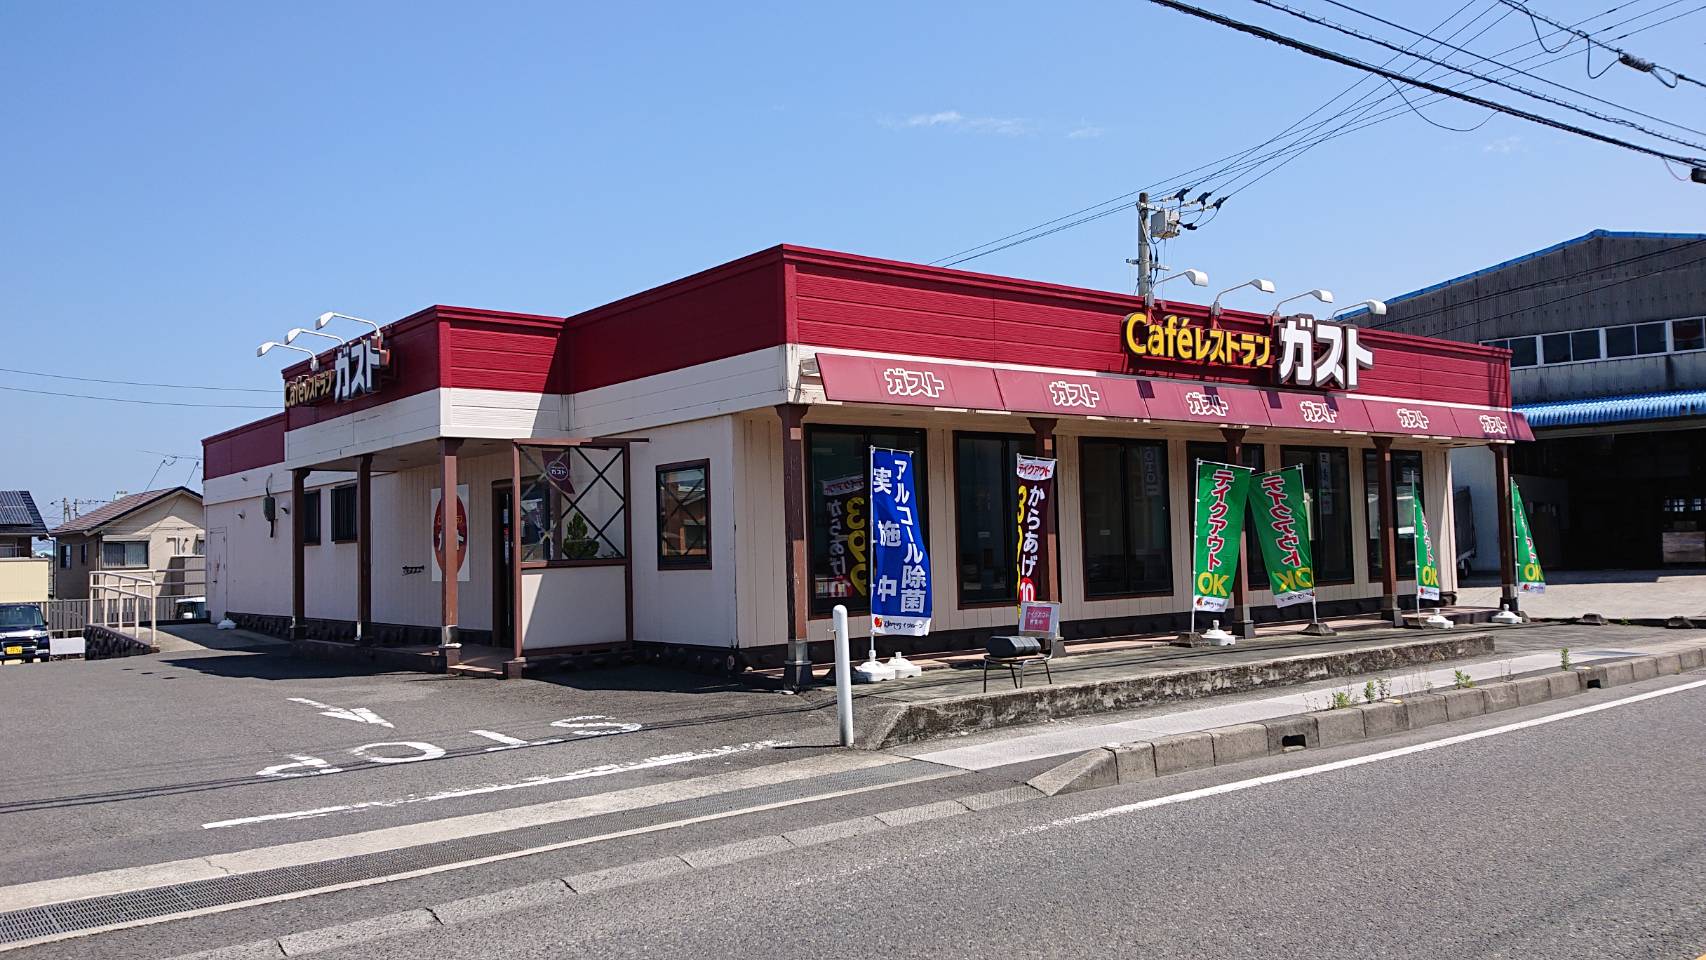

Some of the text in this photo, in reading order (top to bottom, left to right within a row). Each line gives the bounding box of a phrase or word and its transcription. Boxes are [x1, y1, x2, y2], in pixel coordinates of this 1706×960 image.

[1126, 312, 1374, 388] Caféレストラン ガスト
[334, 337, 380, 403] ガスト
[884, 368, 945, 398] ガスト
[1049, 380, 1100, 408] ガスト
[1185, 392, 1229, 417] ガスト
[1300, 401, 1338, 424] ガスト
[1396, 408, 1430, 430] ガスト
[1479, 415, 1508, 434] ガスト
[1018, 464, 1051, 476] テイクアウト
[873, 467, 902, 602] 実施中
[1021, 485, 1046, 578] からあげ
[1206, 469, 1235, 572] テイクアウト
[893, 459, 927, 613] アルコール除菌
[1197, 571, 1230, 597] OK
